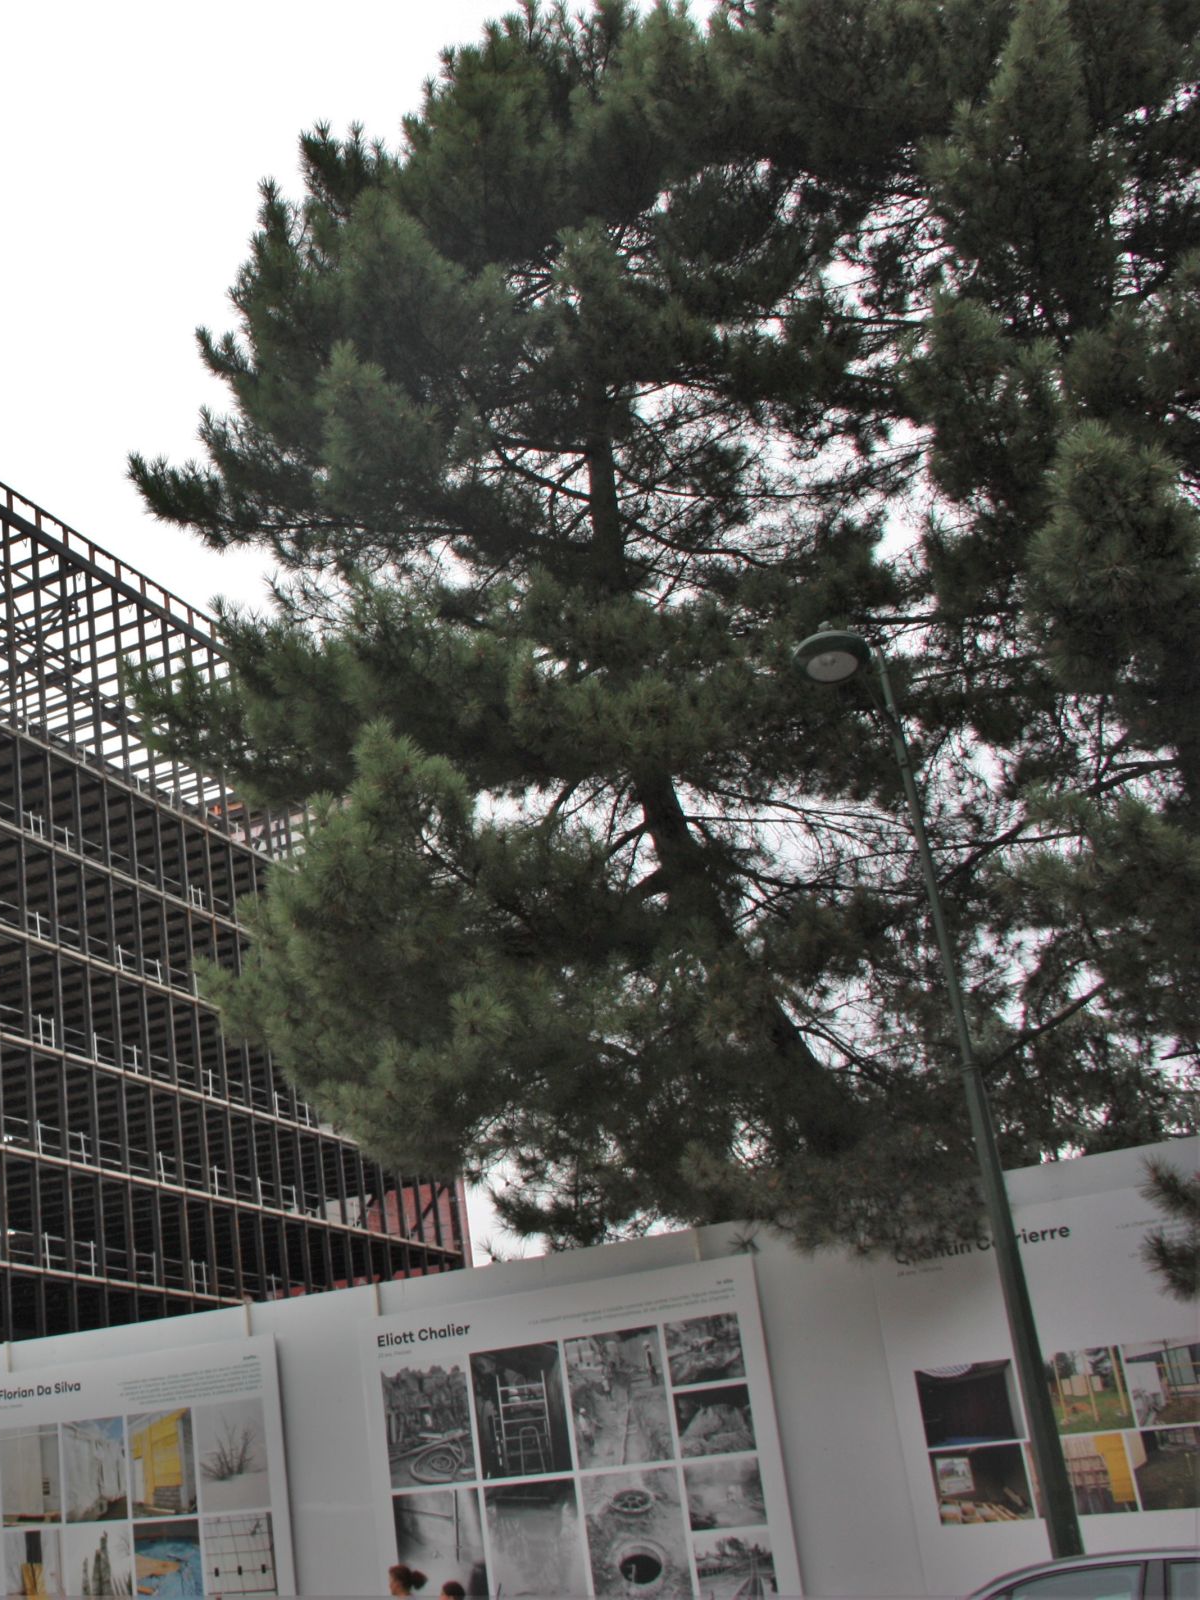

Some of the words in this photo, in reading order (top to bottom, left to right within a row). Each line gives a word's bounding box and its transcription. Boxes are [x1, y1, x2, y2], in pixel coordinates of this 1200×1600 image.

[976, 1226, 1070, 1251] Crierre
[377, 1331, 415, 1348] Eliott
[417, 1323, 471, 1341] Chalier
[36, 1384, 52, 1396] Da
[54, 1381, 81, 1394] Silva
